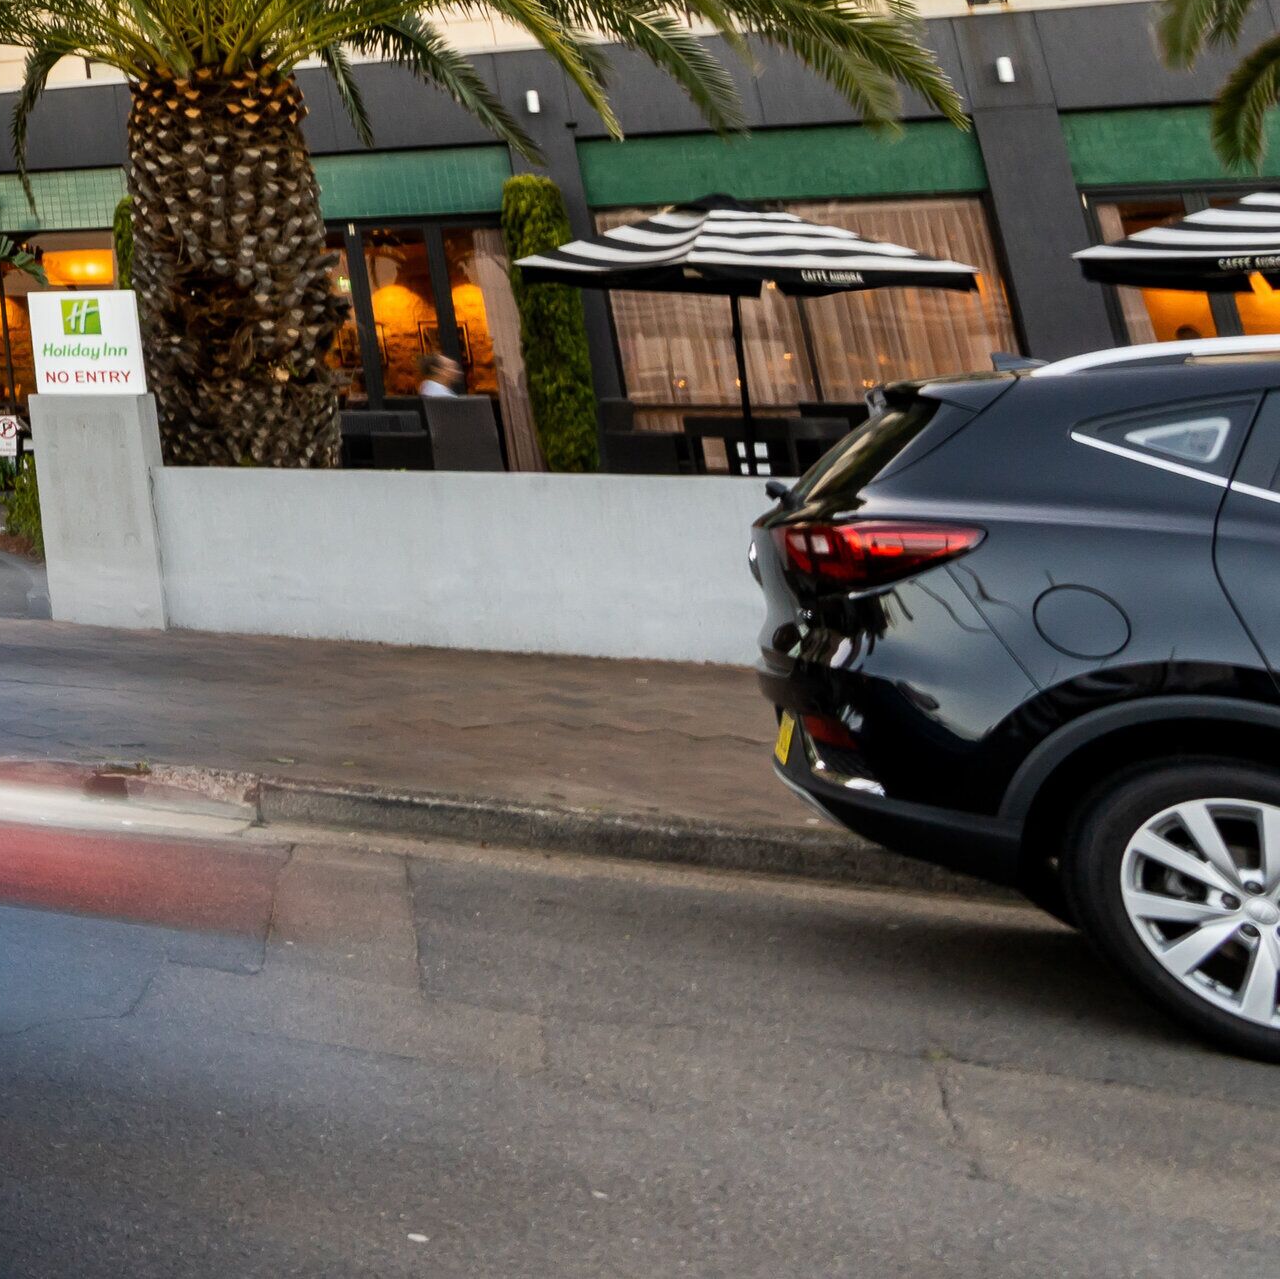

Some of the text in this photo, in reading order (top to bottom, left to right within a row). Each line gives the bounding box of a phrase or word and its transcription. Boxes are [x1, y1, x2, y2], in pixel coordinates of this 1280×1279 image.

[43, 341, 128, 360] Holiday Inn
[45, 370, 131, 384] NO ENTRY
